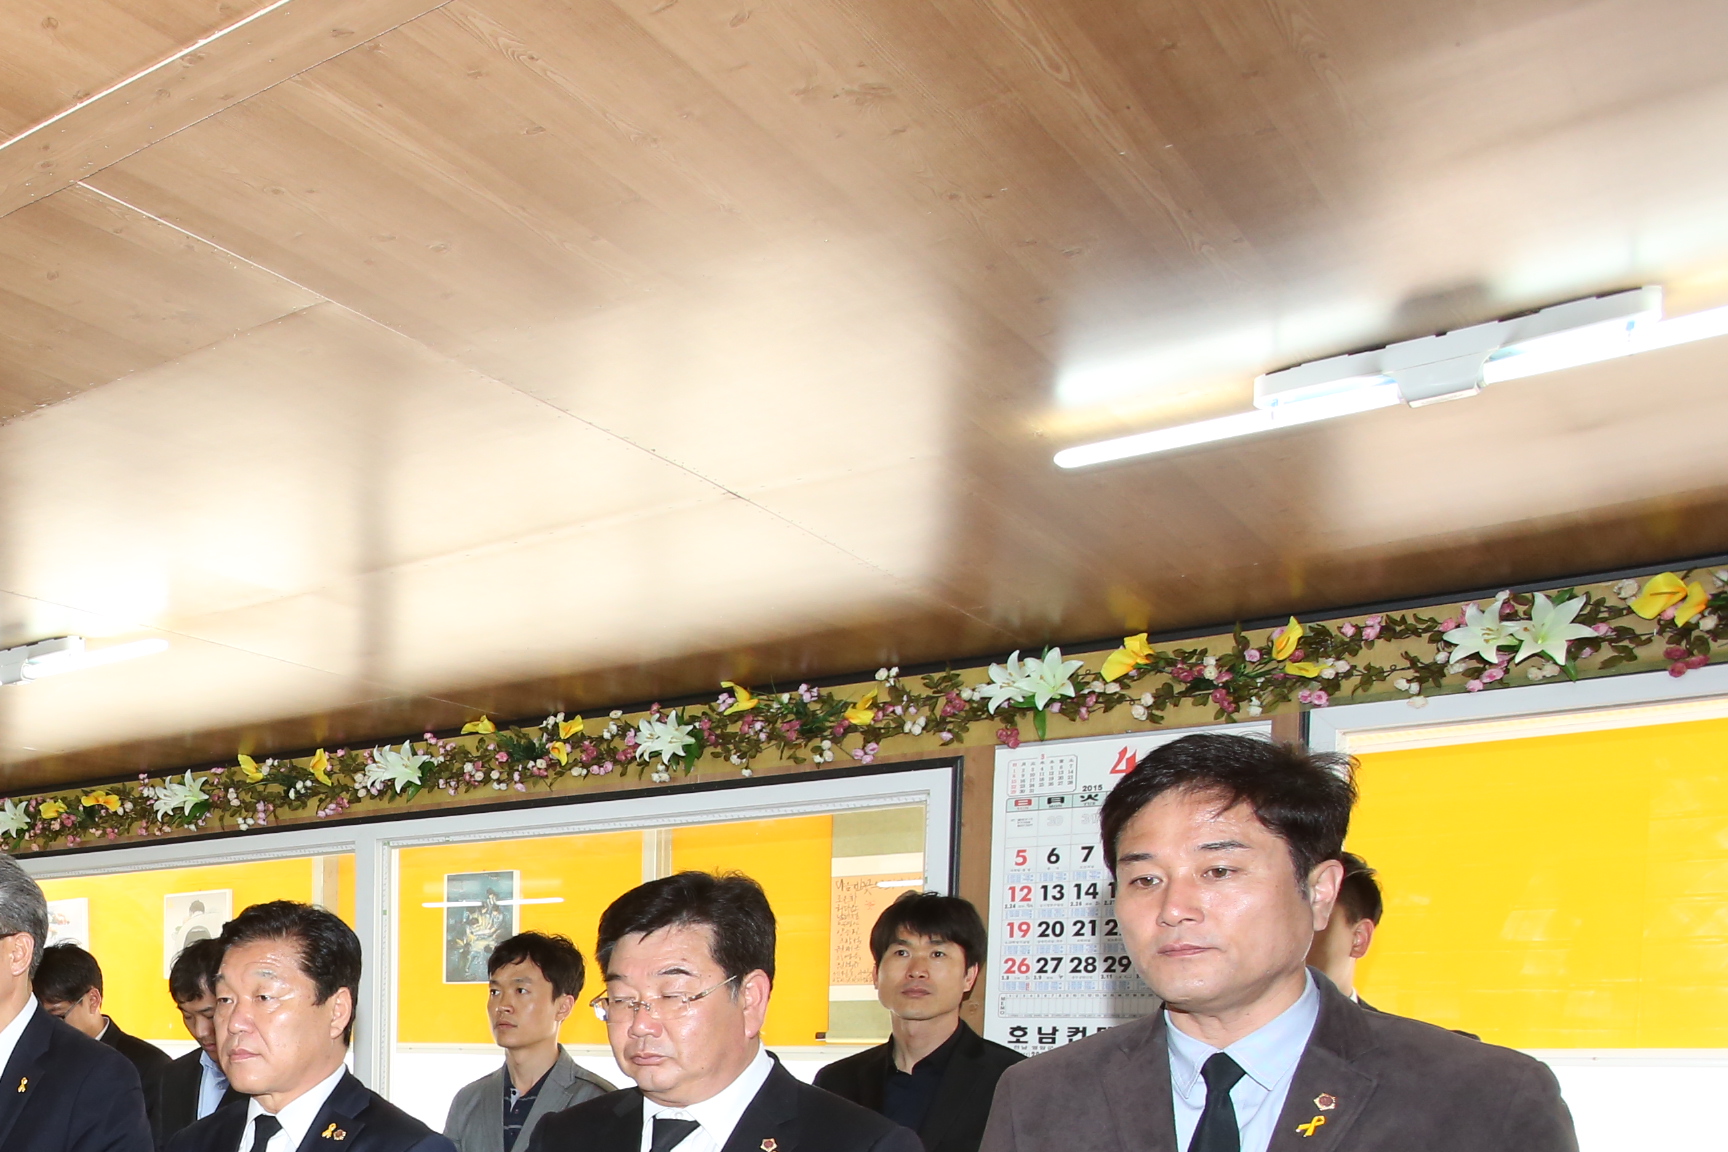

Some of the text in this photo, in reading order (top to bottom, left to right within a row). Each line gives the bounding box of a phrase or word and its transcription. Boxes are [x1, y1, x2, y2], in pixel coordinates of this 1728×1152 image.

[1014, 794, 1099, 807] 日 月 火
[1014, 846, 1095, 866] 5 6 7
[1008, 885, 1032, 902] 12
[1040, 884, 1064, 901] 13
[1073, 882, 1098, 900] 14
[1007, 919, 1122, 938] 19 20 21 2
[1003, 956, 1132, 974] 26 27 28 29
[1008, 1025, 1112, 1044] 호남컨
